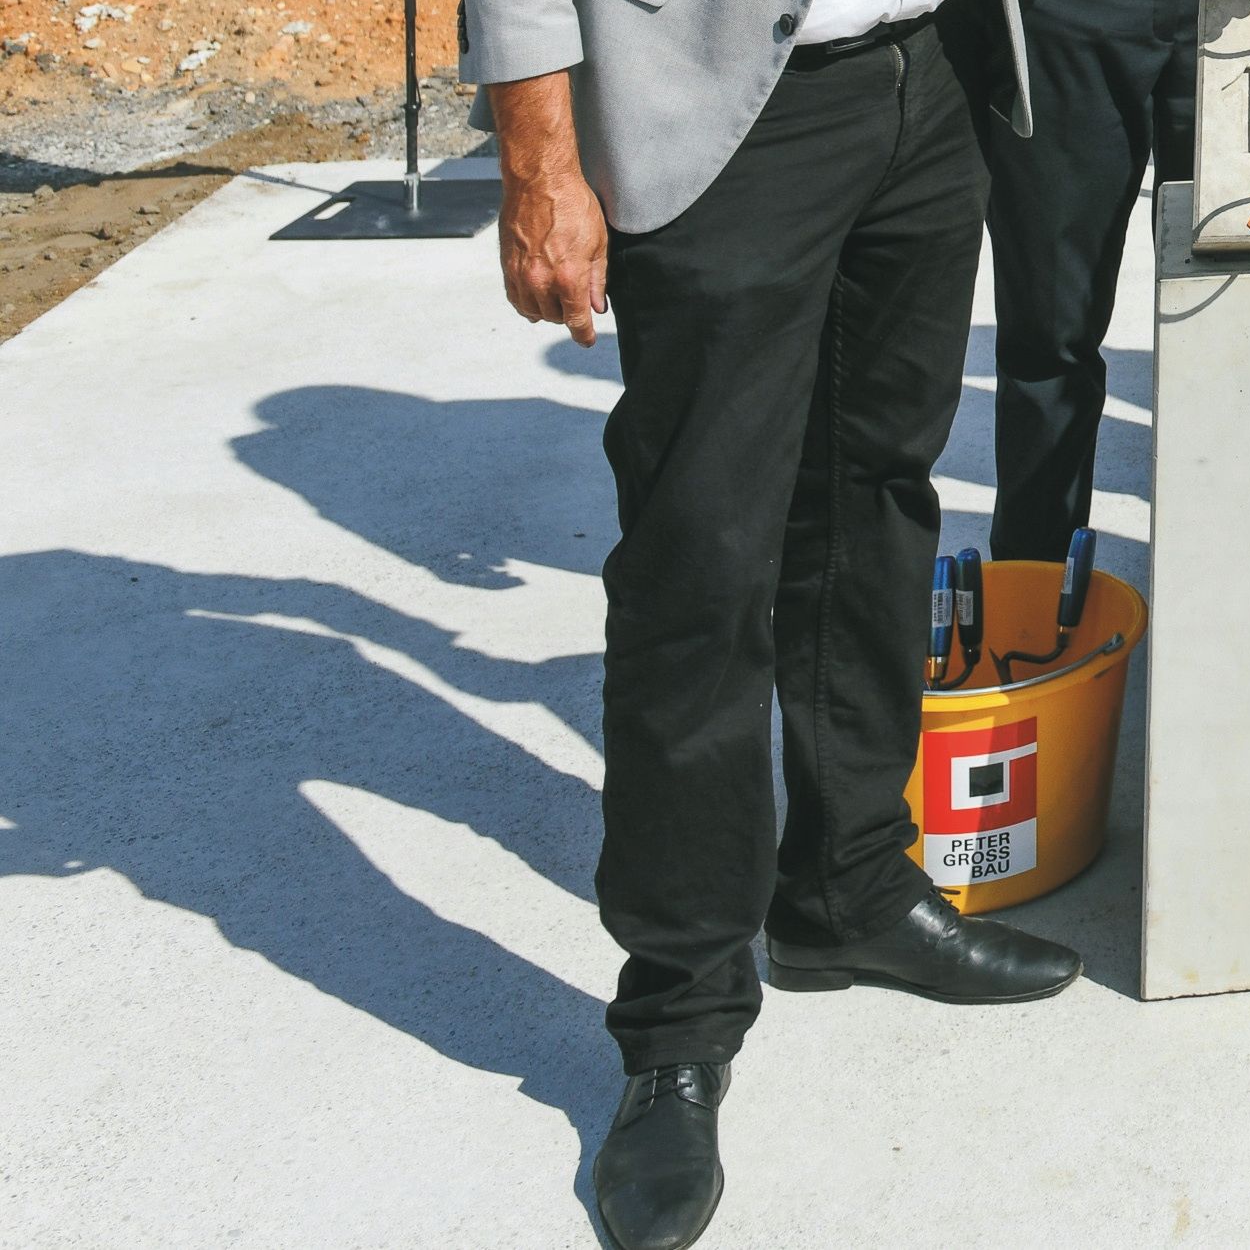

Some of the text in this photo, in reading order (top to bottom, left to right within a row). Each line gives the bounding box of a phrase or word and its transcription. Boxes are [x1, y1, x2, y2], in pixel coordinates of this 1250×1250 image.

[951, 832, 1010, 853] PETER
[943, 845, 1010, 867] GROSS
[971, 859, 1010, 879] BAU
